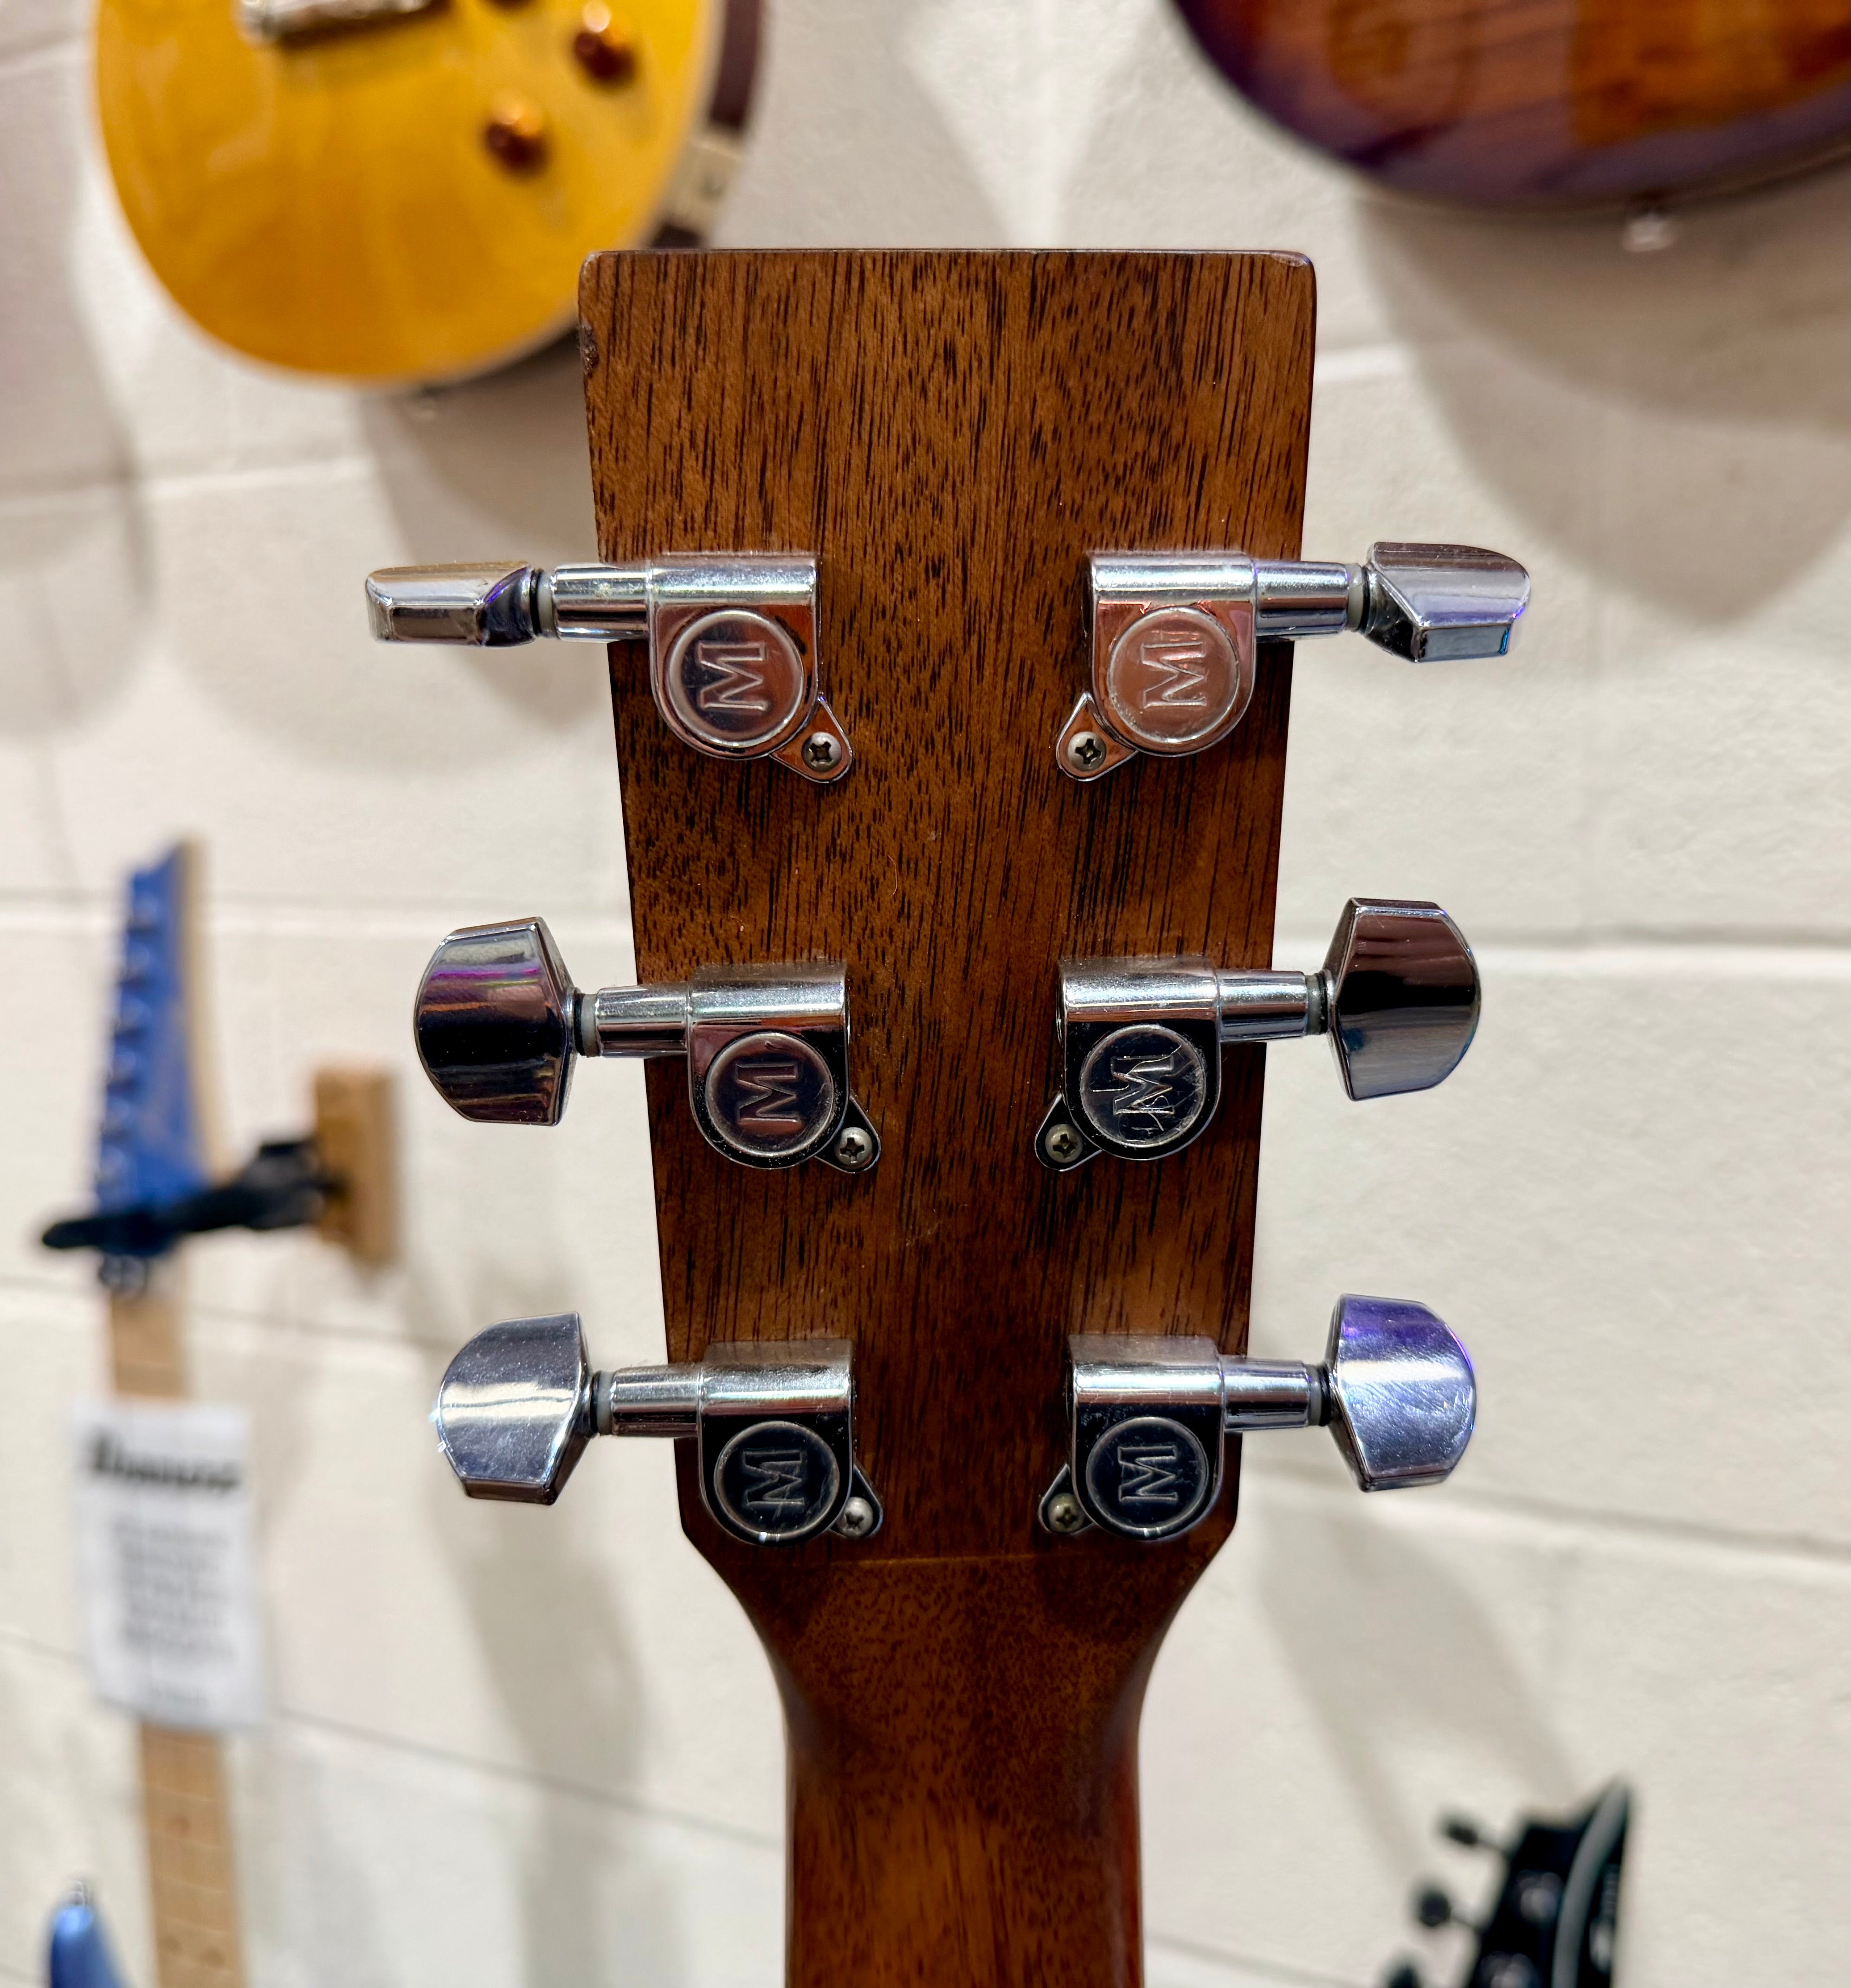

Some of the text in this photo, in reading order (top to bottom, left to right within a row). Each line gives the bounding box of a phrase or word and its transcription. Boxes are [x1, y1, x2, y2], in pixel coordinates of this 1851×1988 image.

[698, 643, 766, 711] M
[1141, 641, 1206, 708] M
[736, 1064, 800, 1124] M
[1112, 1055, 1174, 1115] M
[743, 1451, 805, 1507] M
[1117, 1446, 1178, 1503] M
